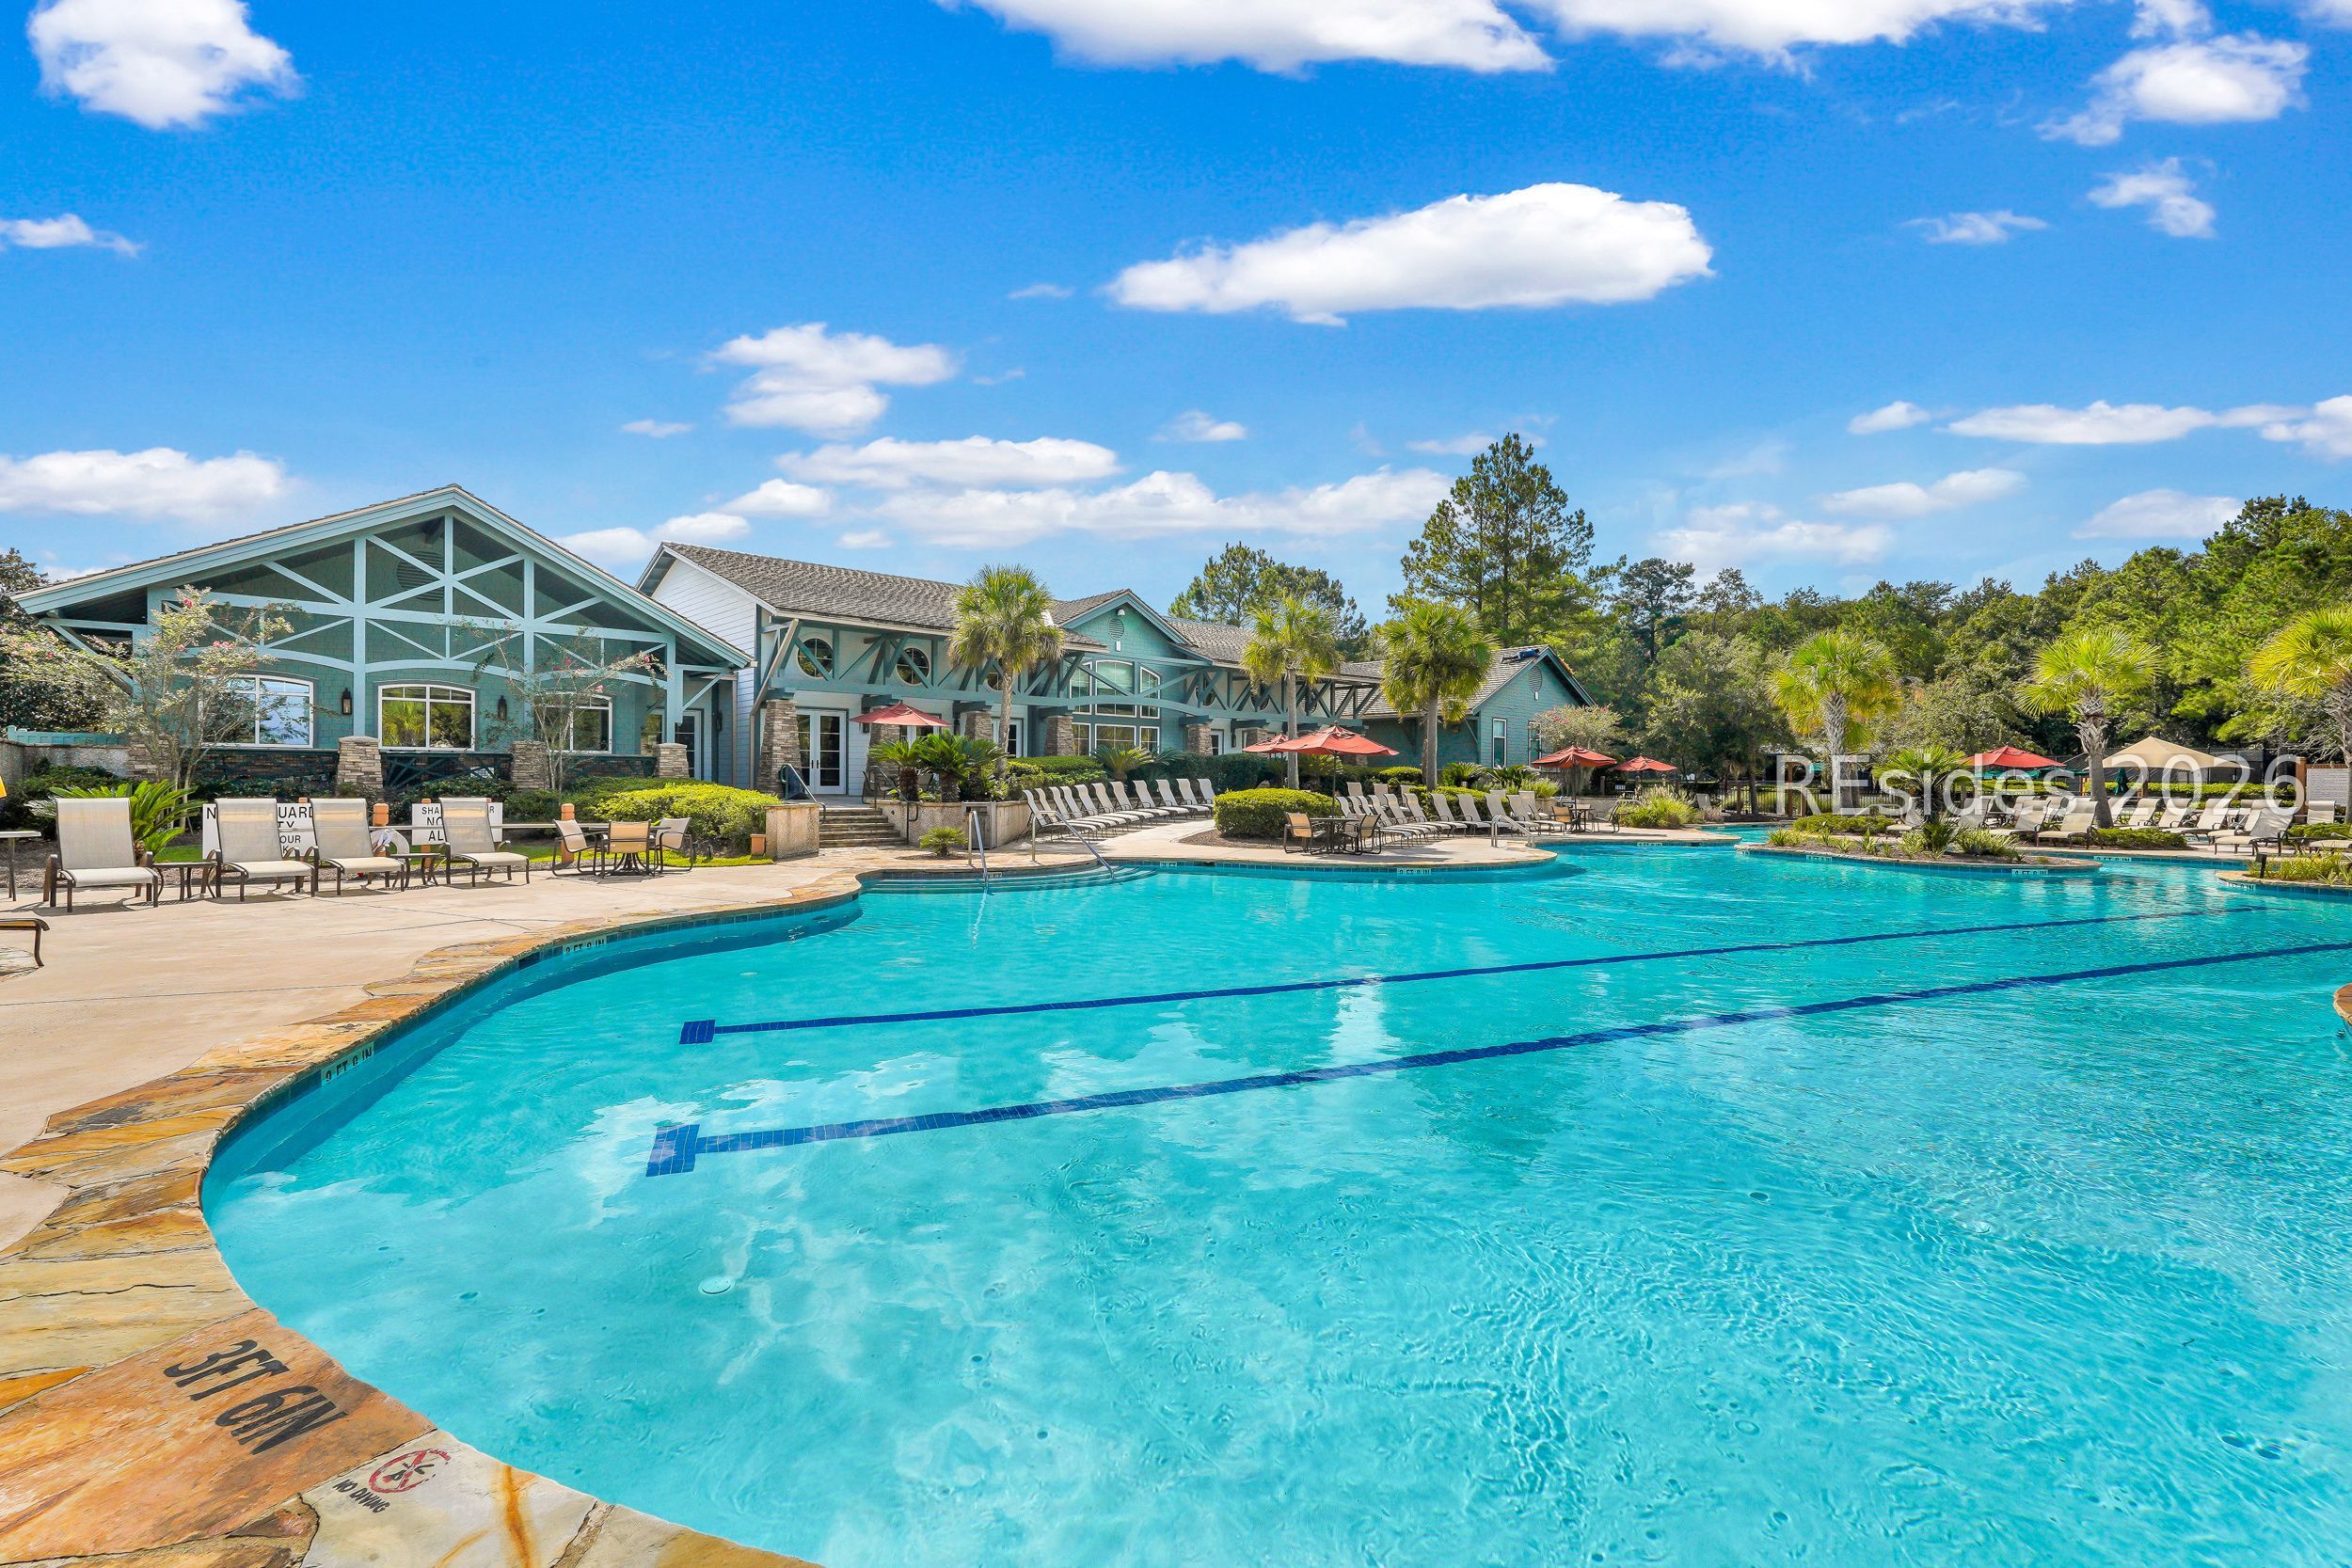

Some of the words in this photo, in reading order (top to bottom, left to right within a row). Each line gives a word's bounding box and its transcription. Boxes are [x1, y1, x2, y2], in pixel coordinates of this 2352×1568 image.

[206, 807, 216, 819] N
[421, 806, 440, 815] SHA
[279, 834, 301, 844] OUR
[164, 1339, 290, 1402] 3FT
[215, 1385, 348, 1455] 6IN
[332, 1479, 358, 1493] NO
[349, 1487, 391, 1513] DIVING
